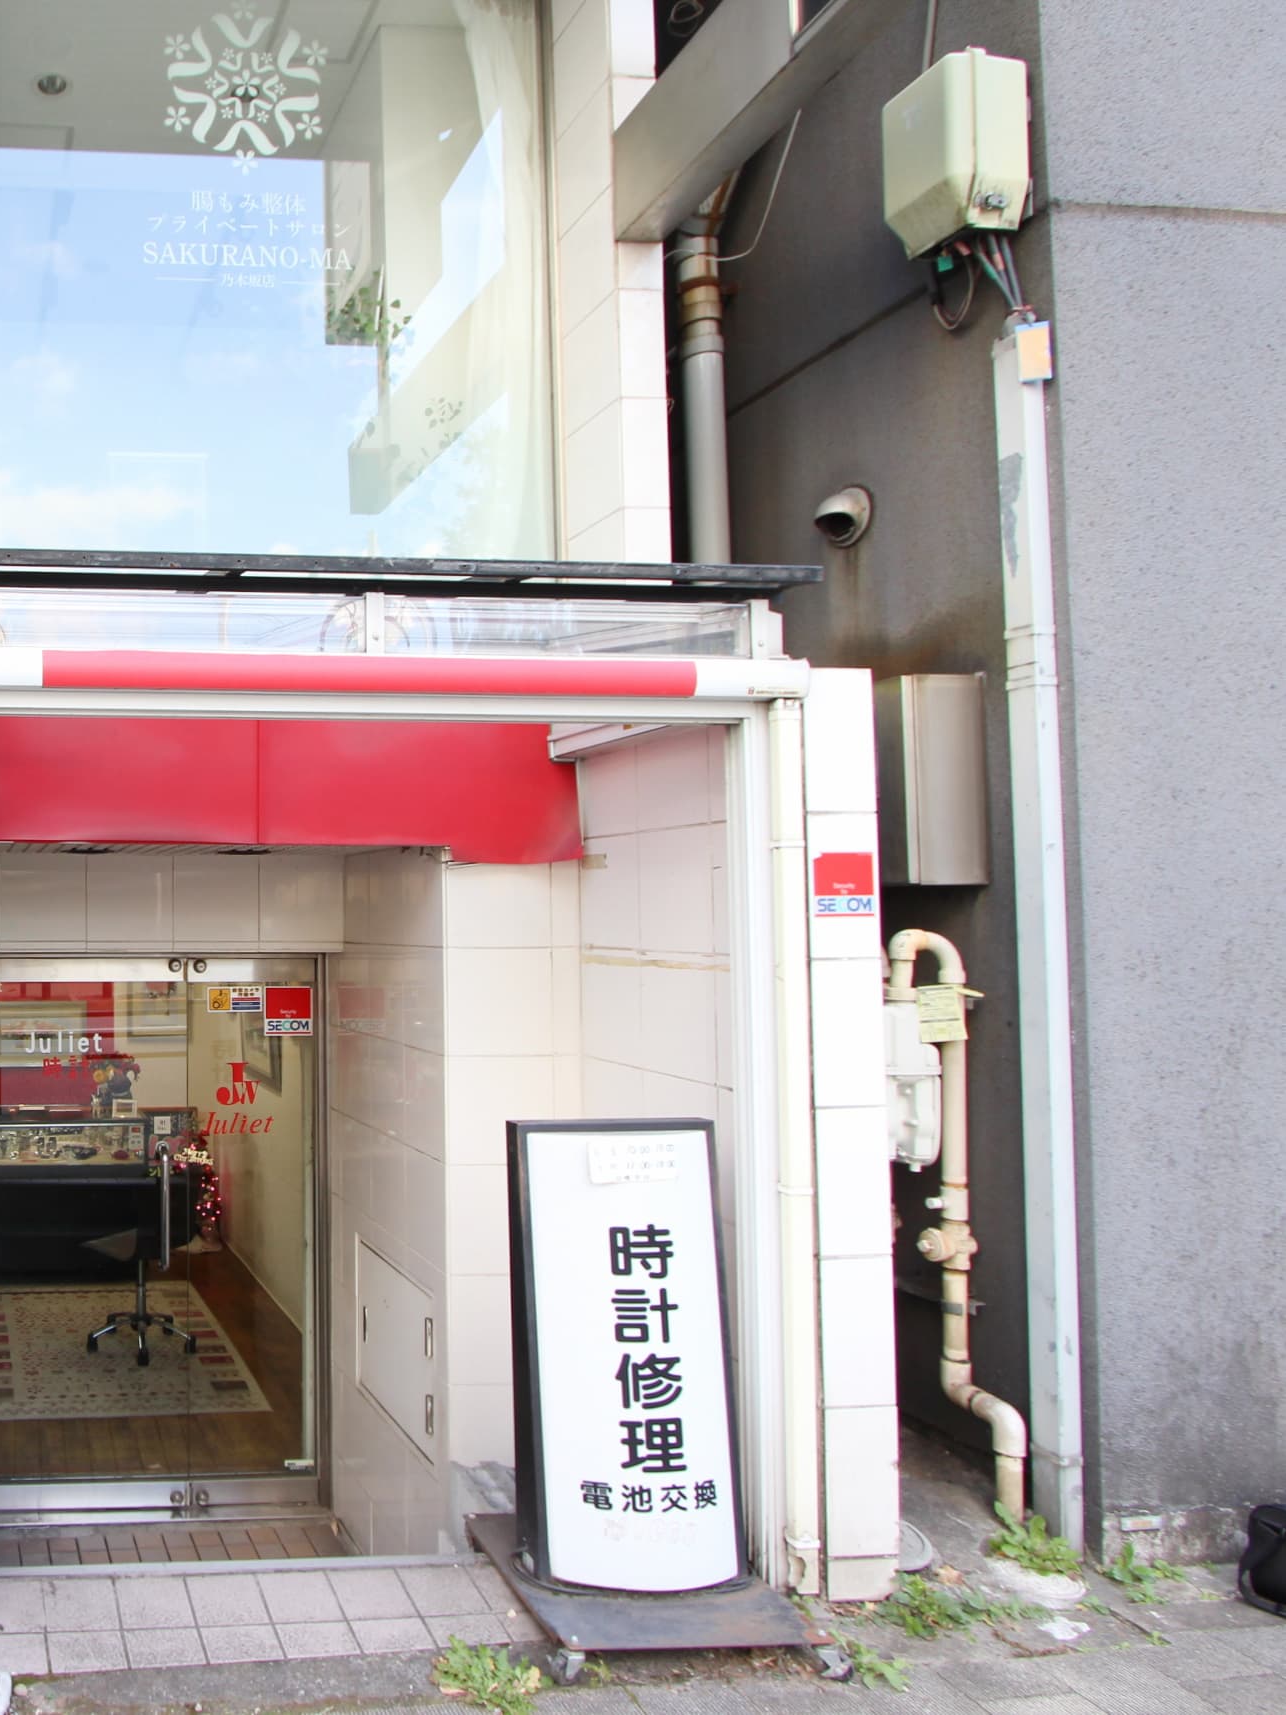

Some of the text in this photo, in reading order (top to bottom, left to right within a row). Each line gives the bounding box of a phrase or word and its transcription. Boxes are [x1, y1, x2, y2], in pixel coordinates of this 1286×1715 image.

[191, 190, 307, 216] 腸もみ整体
[147, 215, 352, 239] プライベートサロン
[142, 241, 353, 271] SAKURANO-MA
[267, 1020, 310, 1031] SECOM
[25, 1030, 103, 1054] Juliet
[201, 1111, 274, 1136] Juliet
[608, 1223, 688, 1473] 時計修理
[580, 1479, 718, 1513] 電池交換
